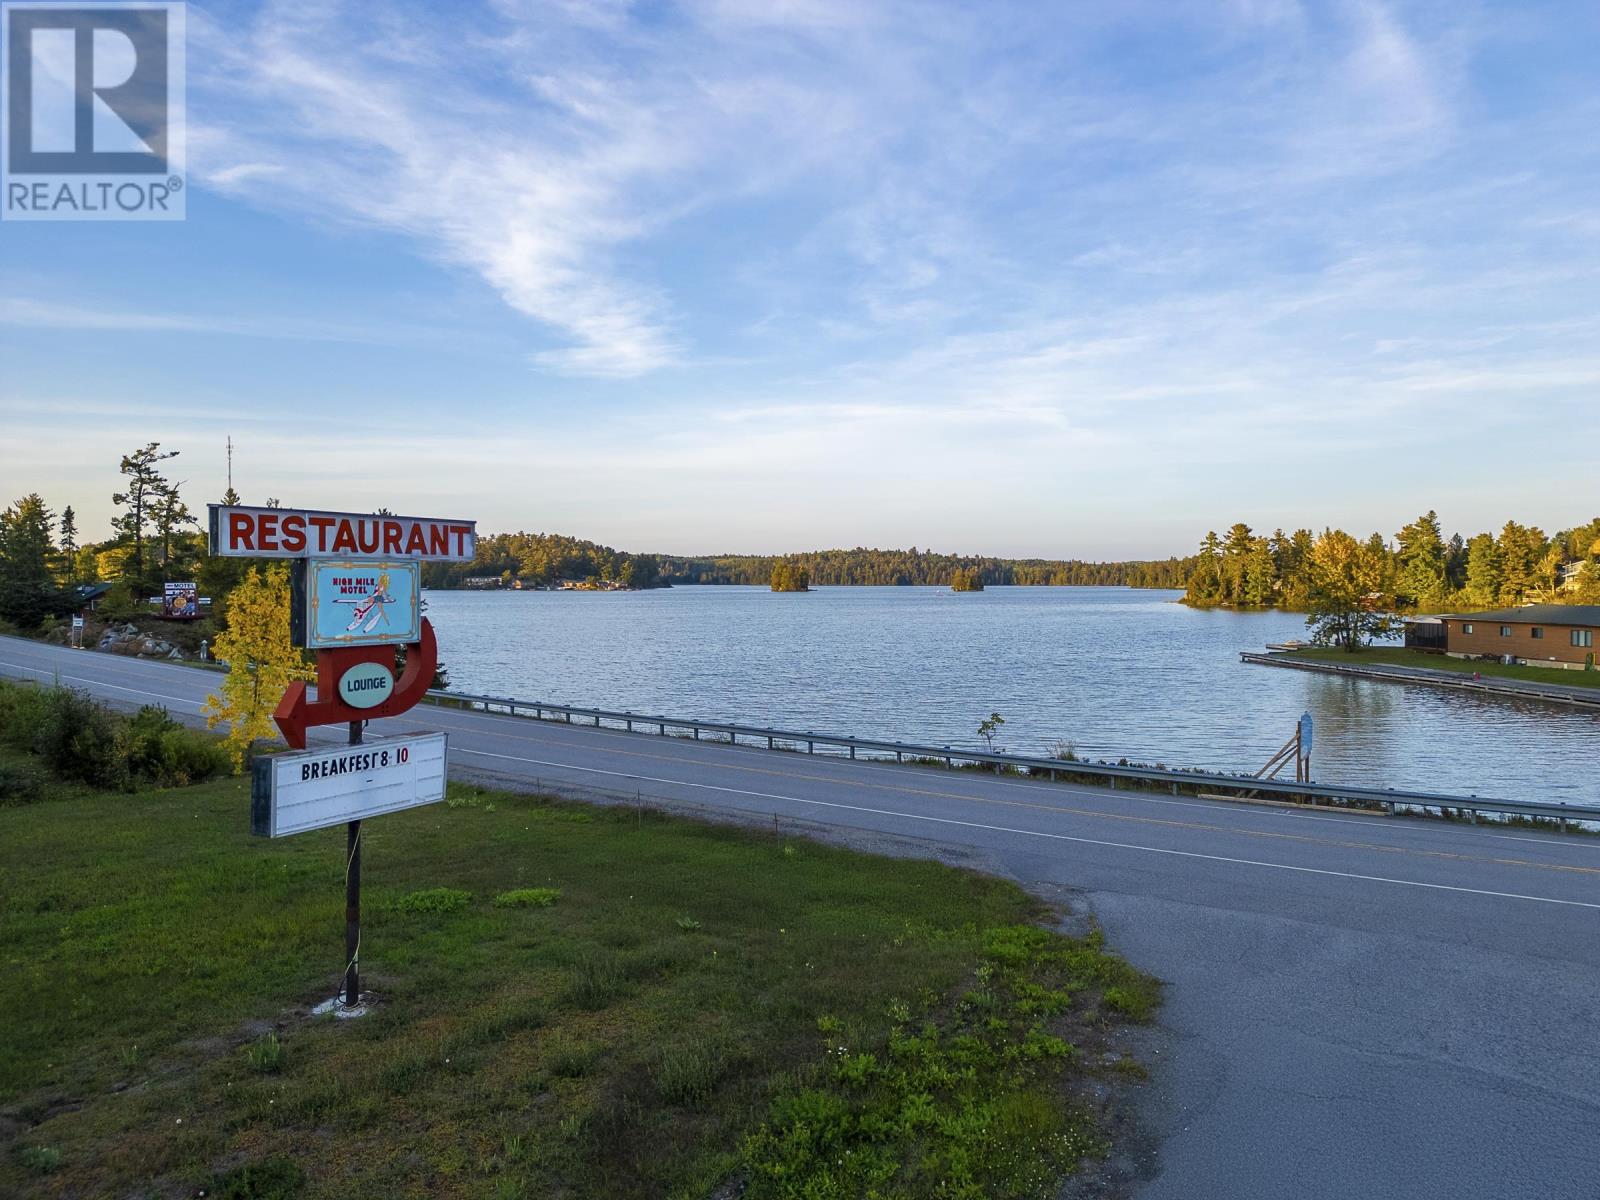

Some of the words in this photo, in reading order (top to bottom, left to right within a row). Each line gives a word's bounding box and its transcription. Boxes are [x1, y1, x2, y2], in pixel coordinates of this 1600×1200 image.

[229, 512, 472, 557] RESTAURANT
[332, 577, 353, 586] HIGH
[355, 577, 375, 586] MILE
[340, 586, 368, 594] MOTEL
[347, 676, 386, 692] LOUNGE
[302, 752, 379, 780] BREAKFEST
